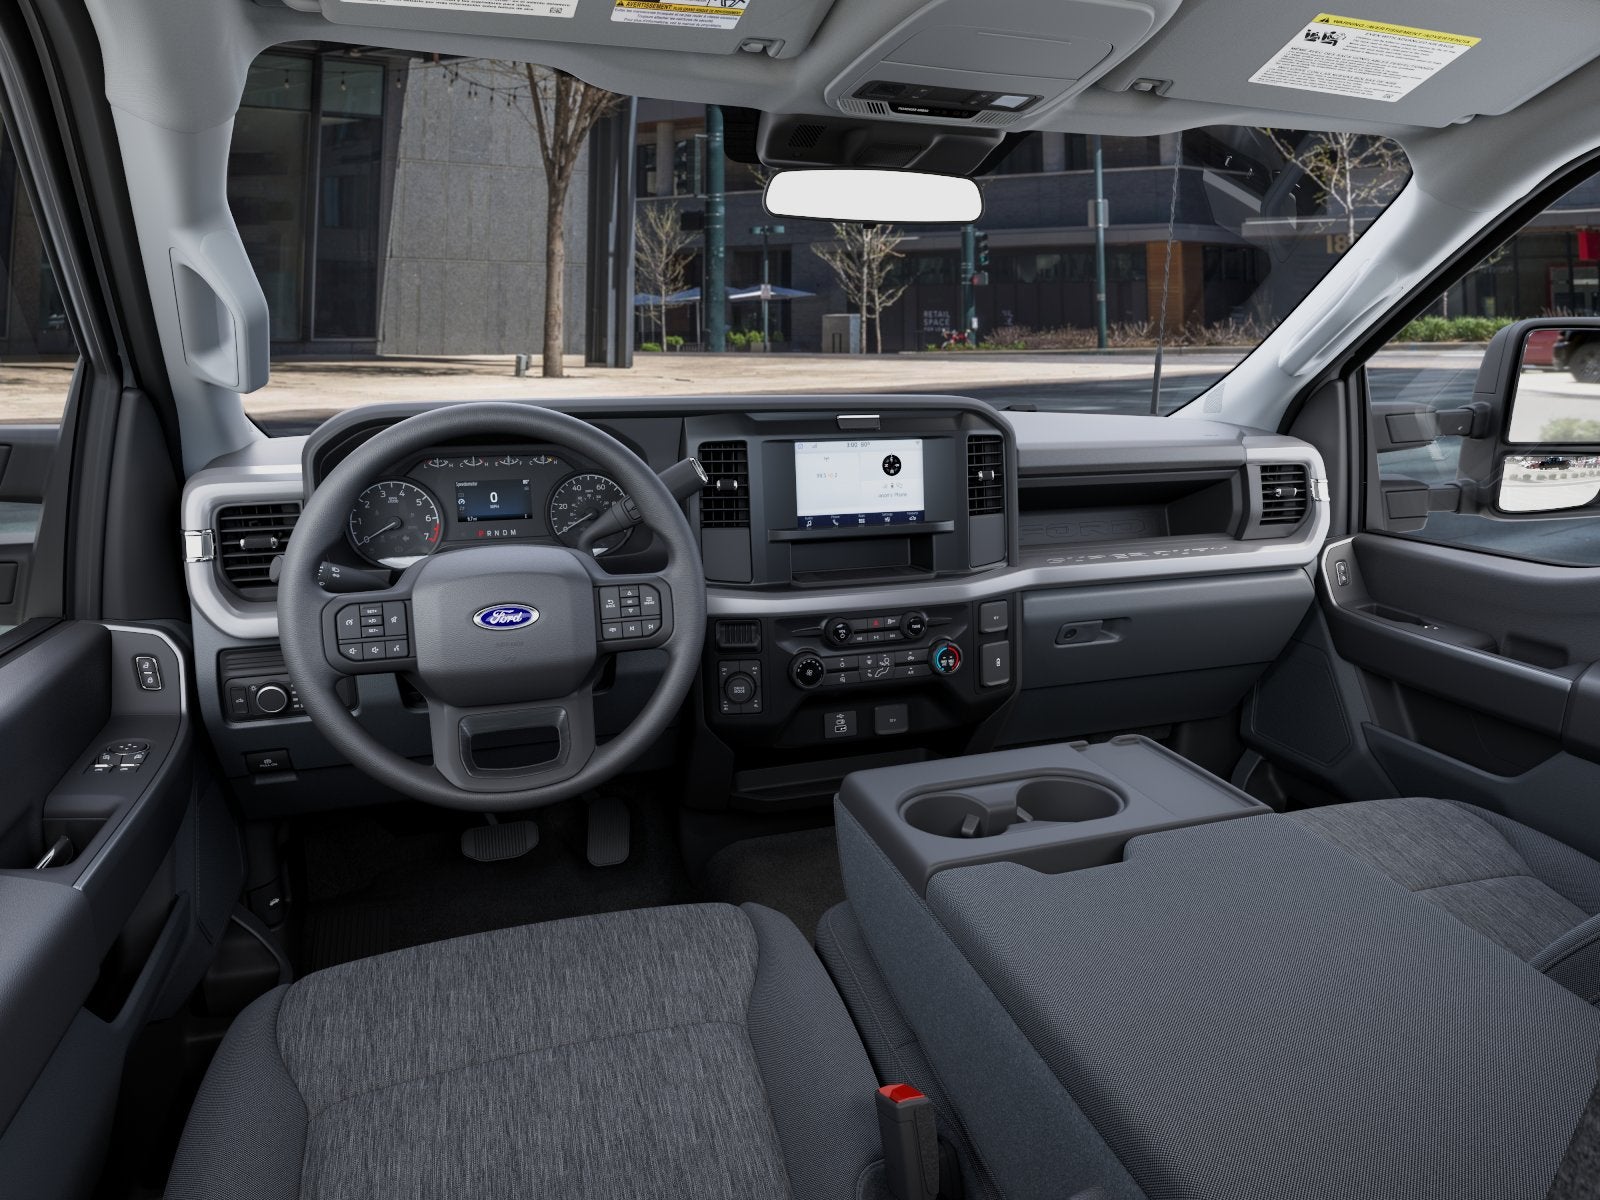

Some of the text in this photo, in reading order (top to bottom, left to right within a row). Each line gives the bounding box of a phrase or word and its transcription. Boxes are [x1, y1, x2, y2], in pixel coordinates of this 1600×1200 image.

[626, 1, 673, 10] AVERTISSEMENT
[1333, 20, 1364, 28] WARNING
[923, 310, 950, 318] RETAIL
[923, 318, 950, 326] SPACE
[572, 484, 582, 492] 40
[596, 483, 606, 491] 60
[380, 490, 386, 498] 3
[489, 491, 498, 503] 0
[364, 501, 370, 509] 2
[425, 514, 431, 522] 6
[423, 532, 429, 540] 7
[489, 609, 522, 624] Ford
